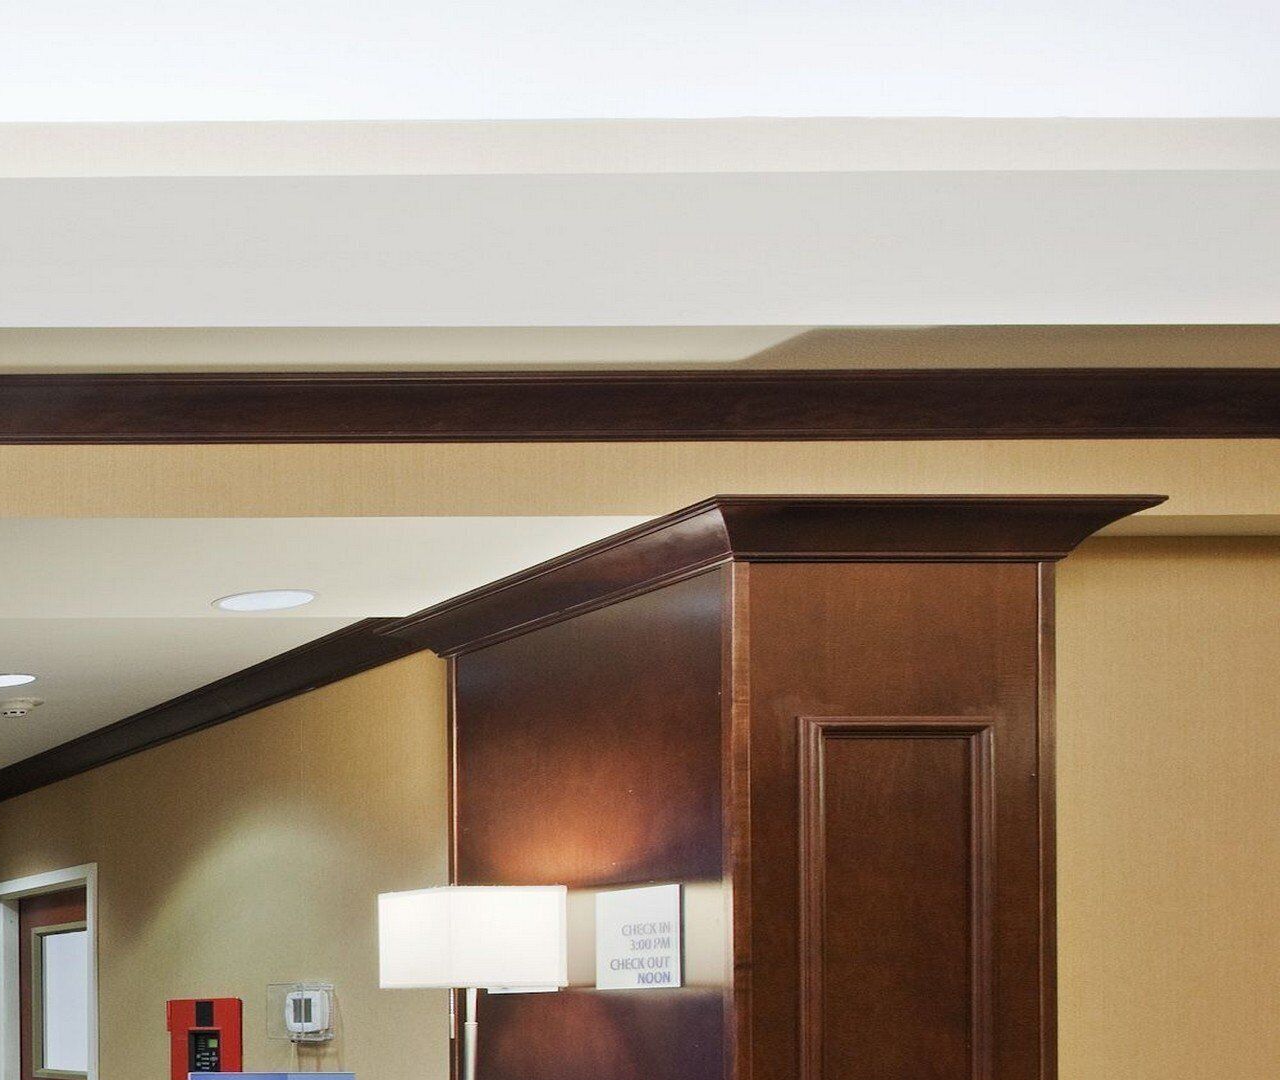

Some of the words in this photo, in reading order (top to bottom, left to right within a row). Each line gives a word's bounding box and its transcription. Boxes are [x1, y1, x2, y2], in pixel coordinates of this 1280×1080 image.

[621, 922, 657, 936] CHECK
[659, 921, 671, 933] IN
[654, 937, 671, 949] PM
[610, 957, 645, 971] CHECK
[647, 955, 671, 969] OUT
[637, 971, 671, 984] NOON
